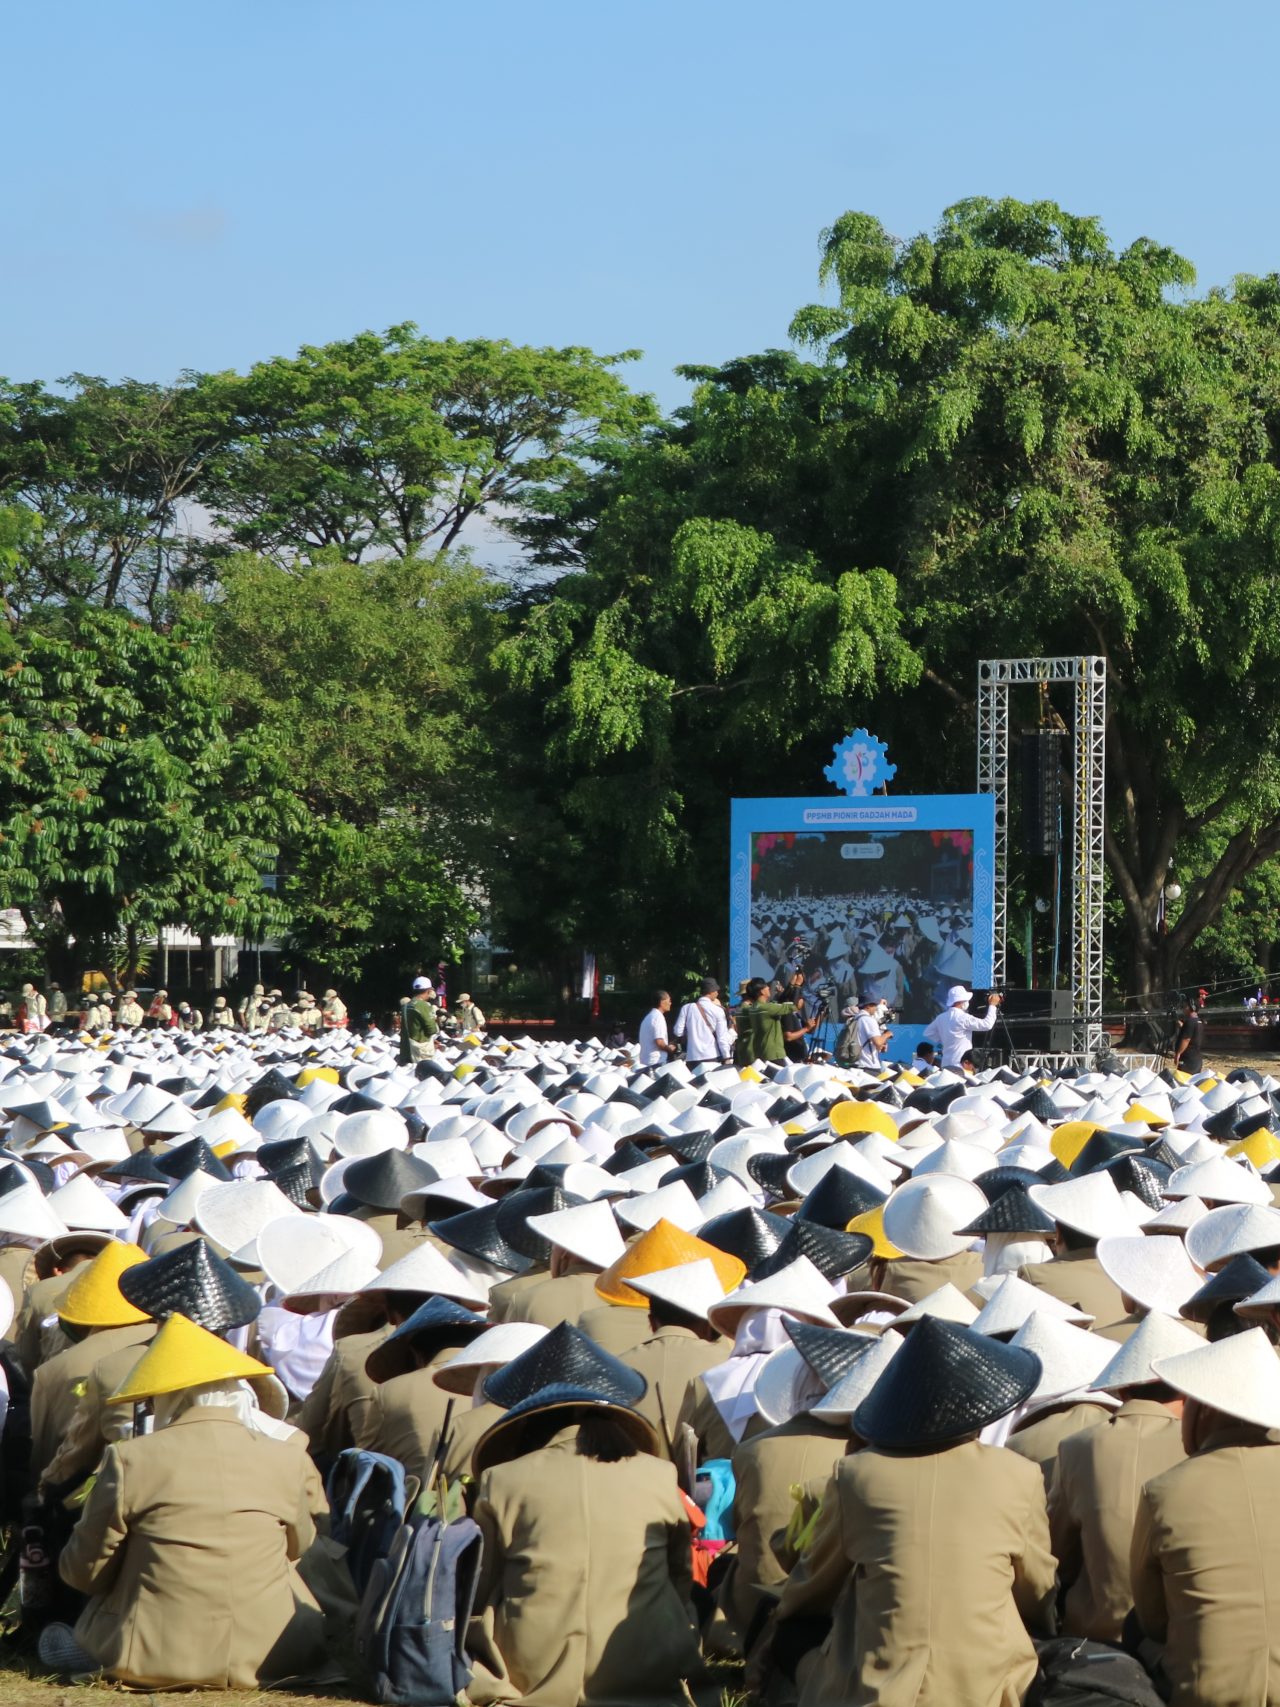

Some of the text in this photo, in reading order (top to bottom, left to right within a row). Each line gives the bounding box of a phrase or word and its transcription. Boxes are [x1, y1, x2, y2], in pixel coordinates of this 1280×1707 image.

[833, 811, 858, 820] PIONIR
[859, 810, 890, 819] GADJAH
[891, 810, 913, 819] MADA
